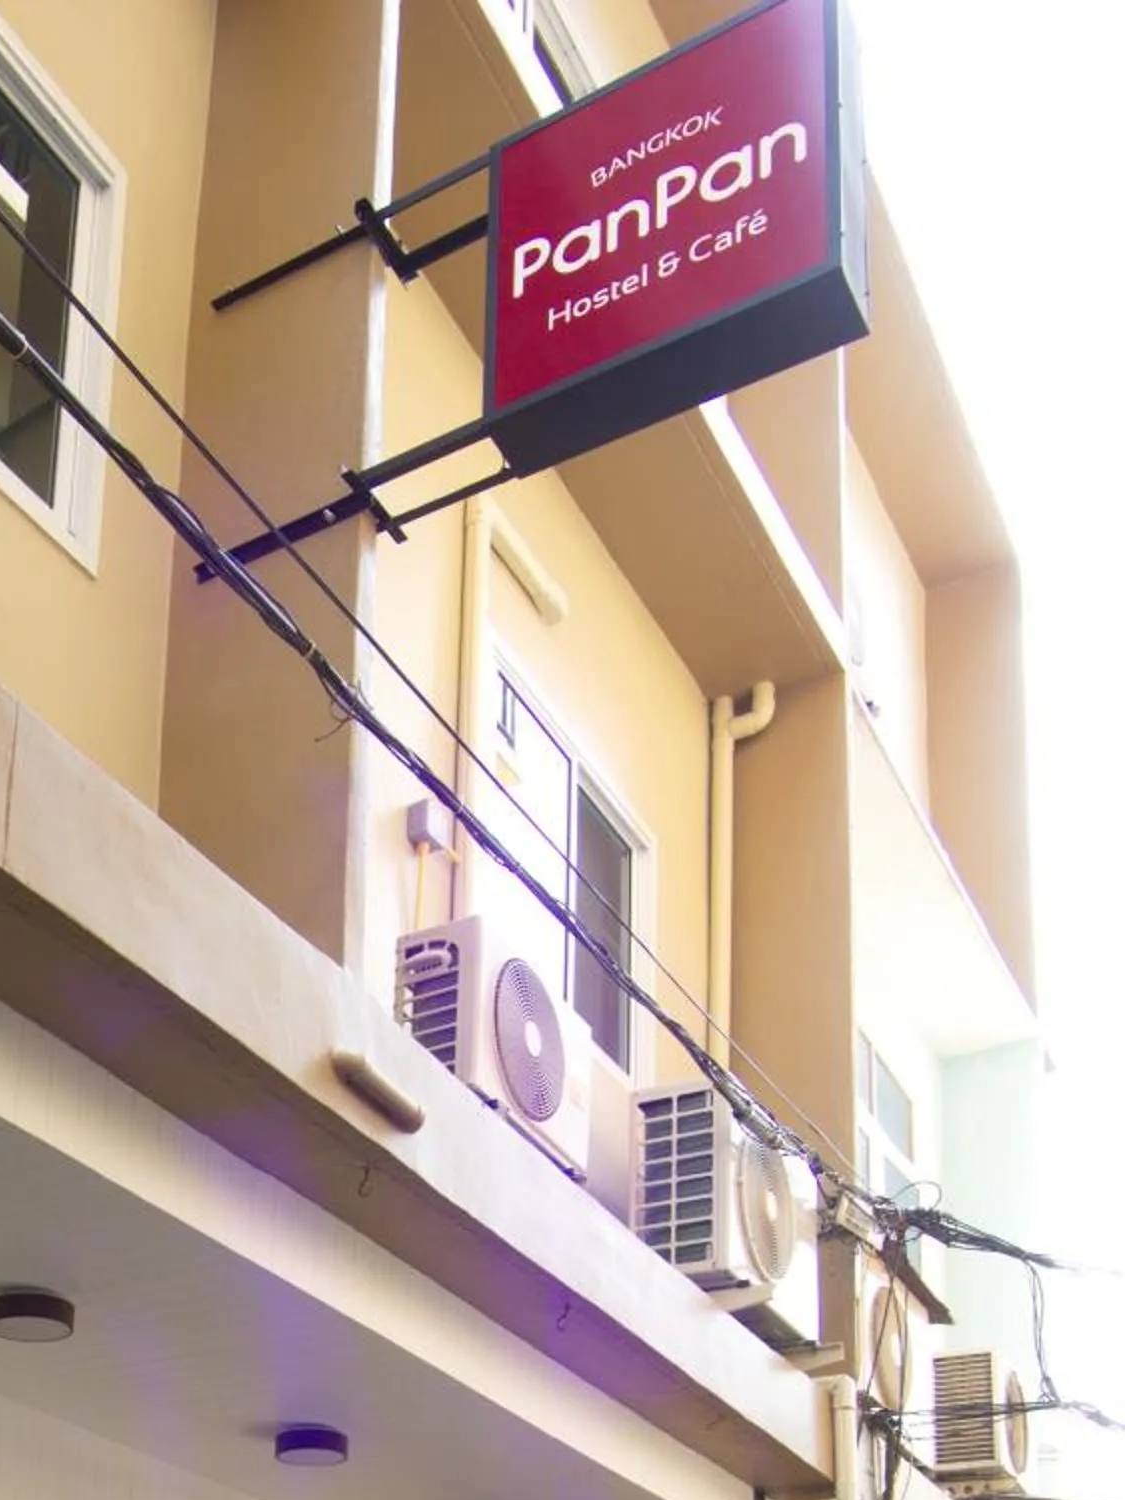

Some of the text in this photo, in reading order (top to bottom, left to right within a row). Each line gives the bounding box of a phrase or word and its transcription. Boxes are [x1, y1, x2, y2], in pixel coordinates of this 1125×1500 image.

[590, 106, 724, 188] BANGKOK
[512, 121, 807, 299] PanPan
[547, 208, 768, 331] Hostel & Café
